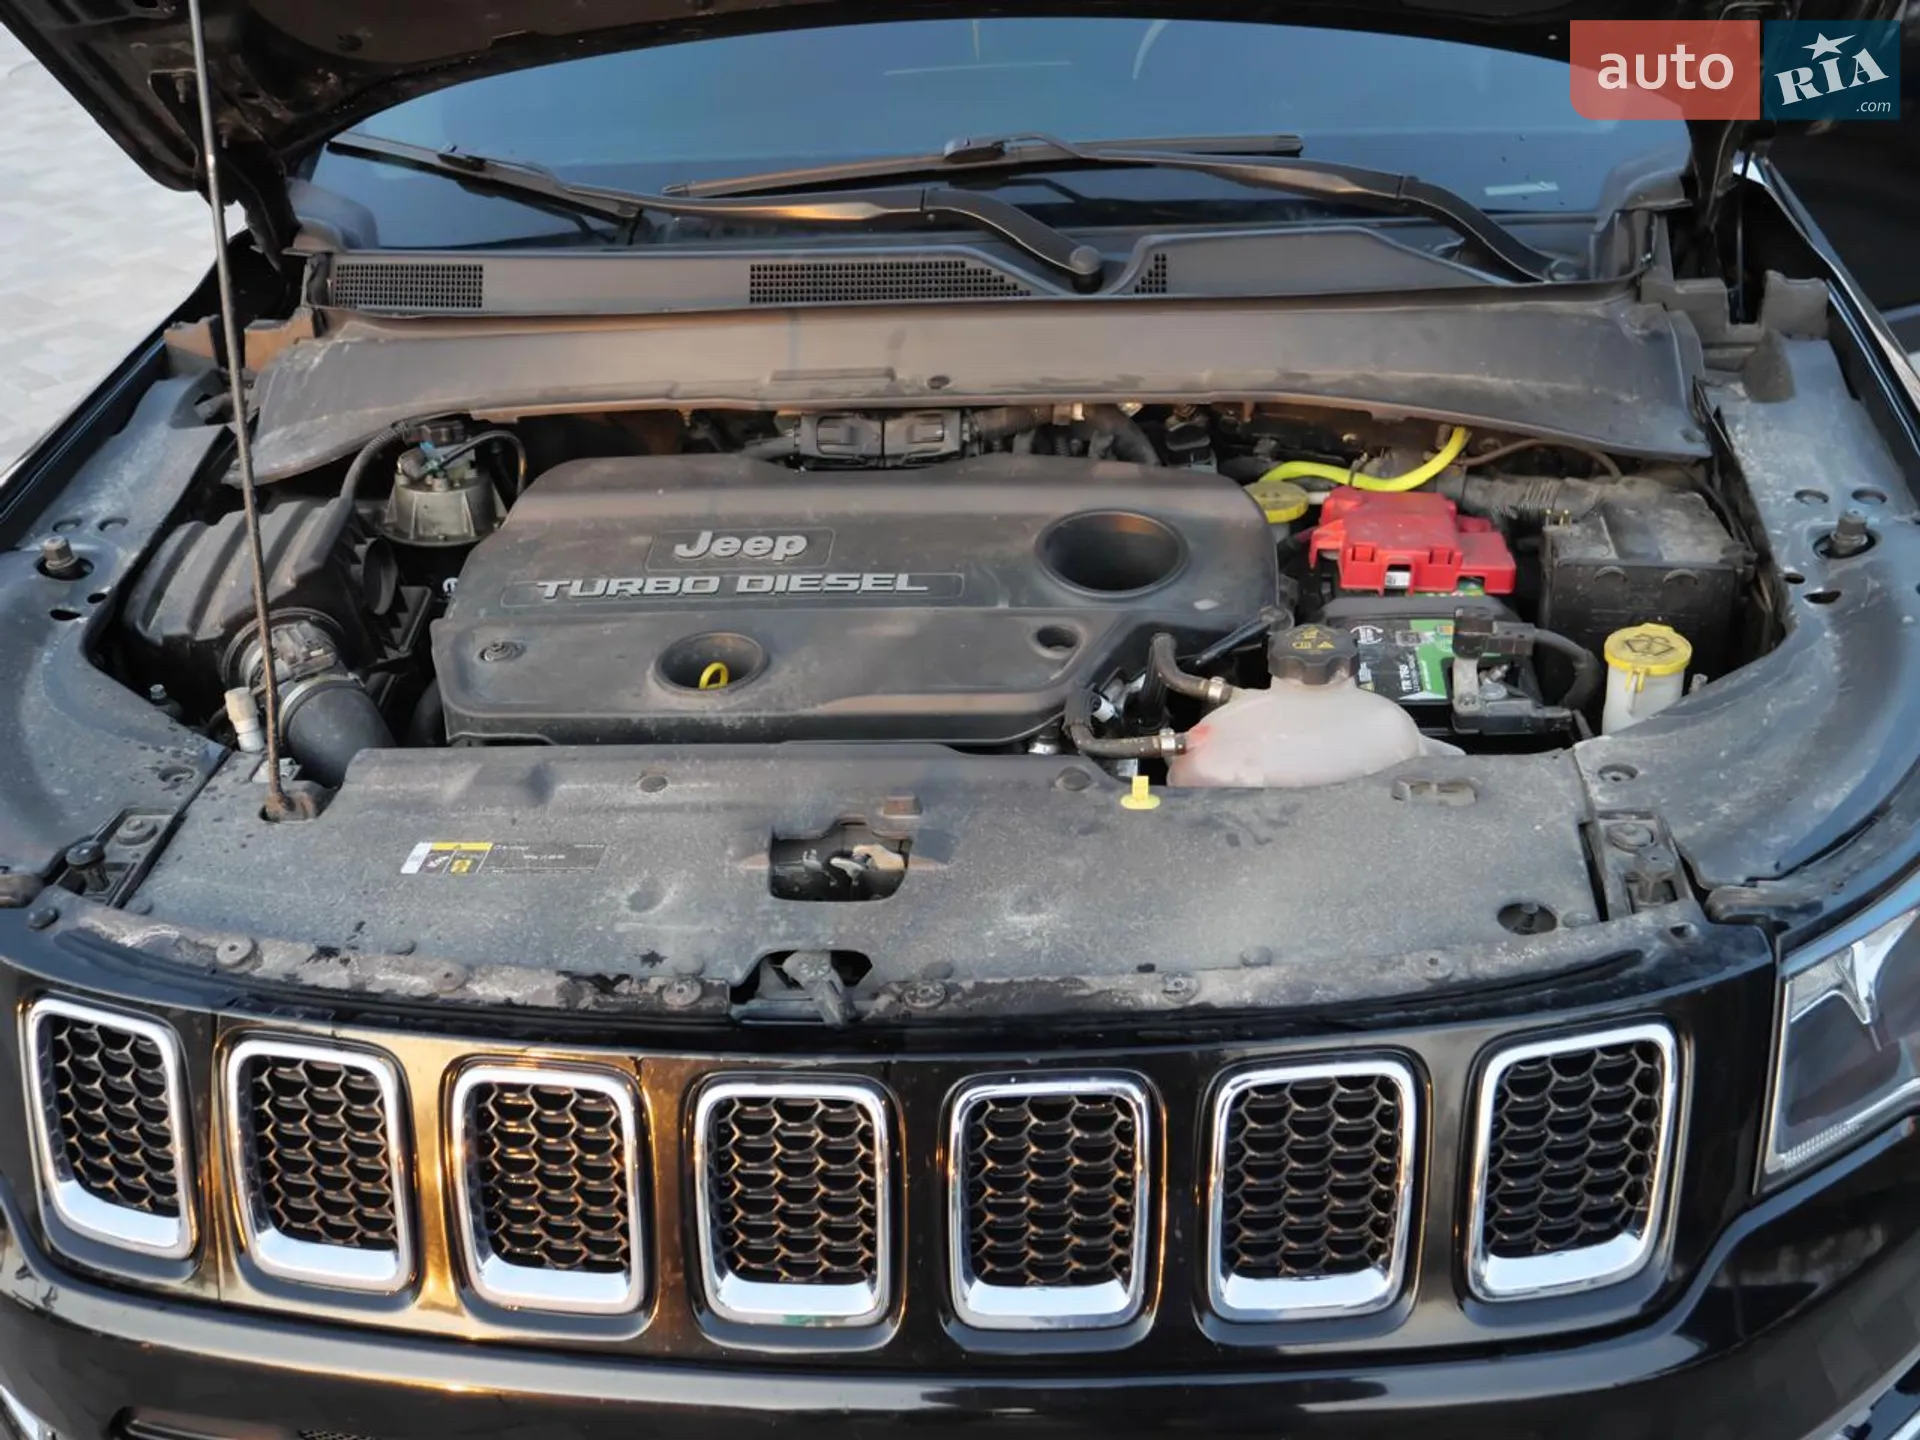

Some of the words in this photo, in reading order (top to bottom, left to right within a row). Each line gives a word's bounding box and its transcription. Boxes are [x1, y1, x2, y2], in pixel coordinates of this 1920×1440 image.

[673, 530, 808, 562] Jeep
[536, 576, 721, 598] TURBO
[735, 574, 929, 596] DIESEL
